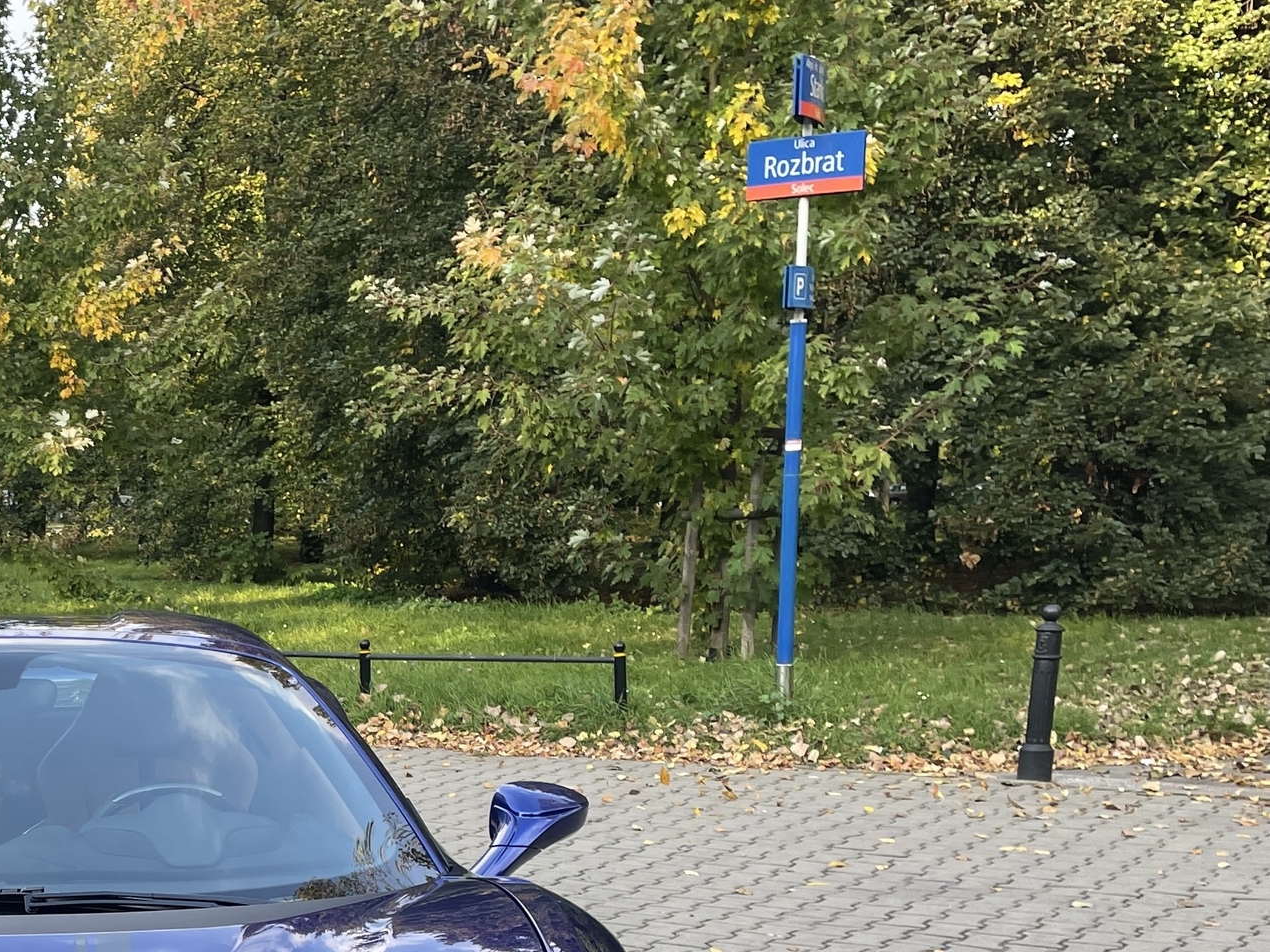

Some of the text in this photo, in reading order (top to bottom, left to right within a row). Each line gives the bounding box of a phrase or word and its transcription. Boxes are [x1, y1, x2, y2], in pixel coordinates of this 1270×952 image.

[794, 139, 815, 150] Ulica
[764, 150, 845, 179] Rozbrat
[791, 183, 815, 195] Solec
[796, 276, 805, 297] P
